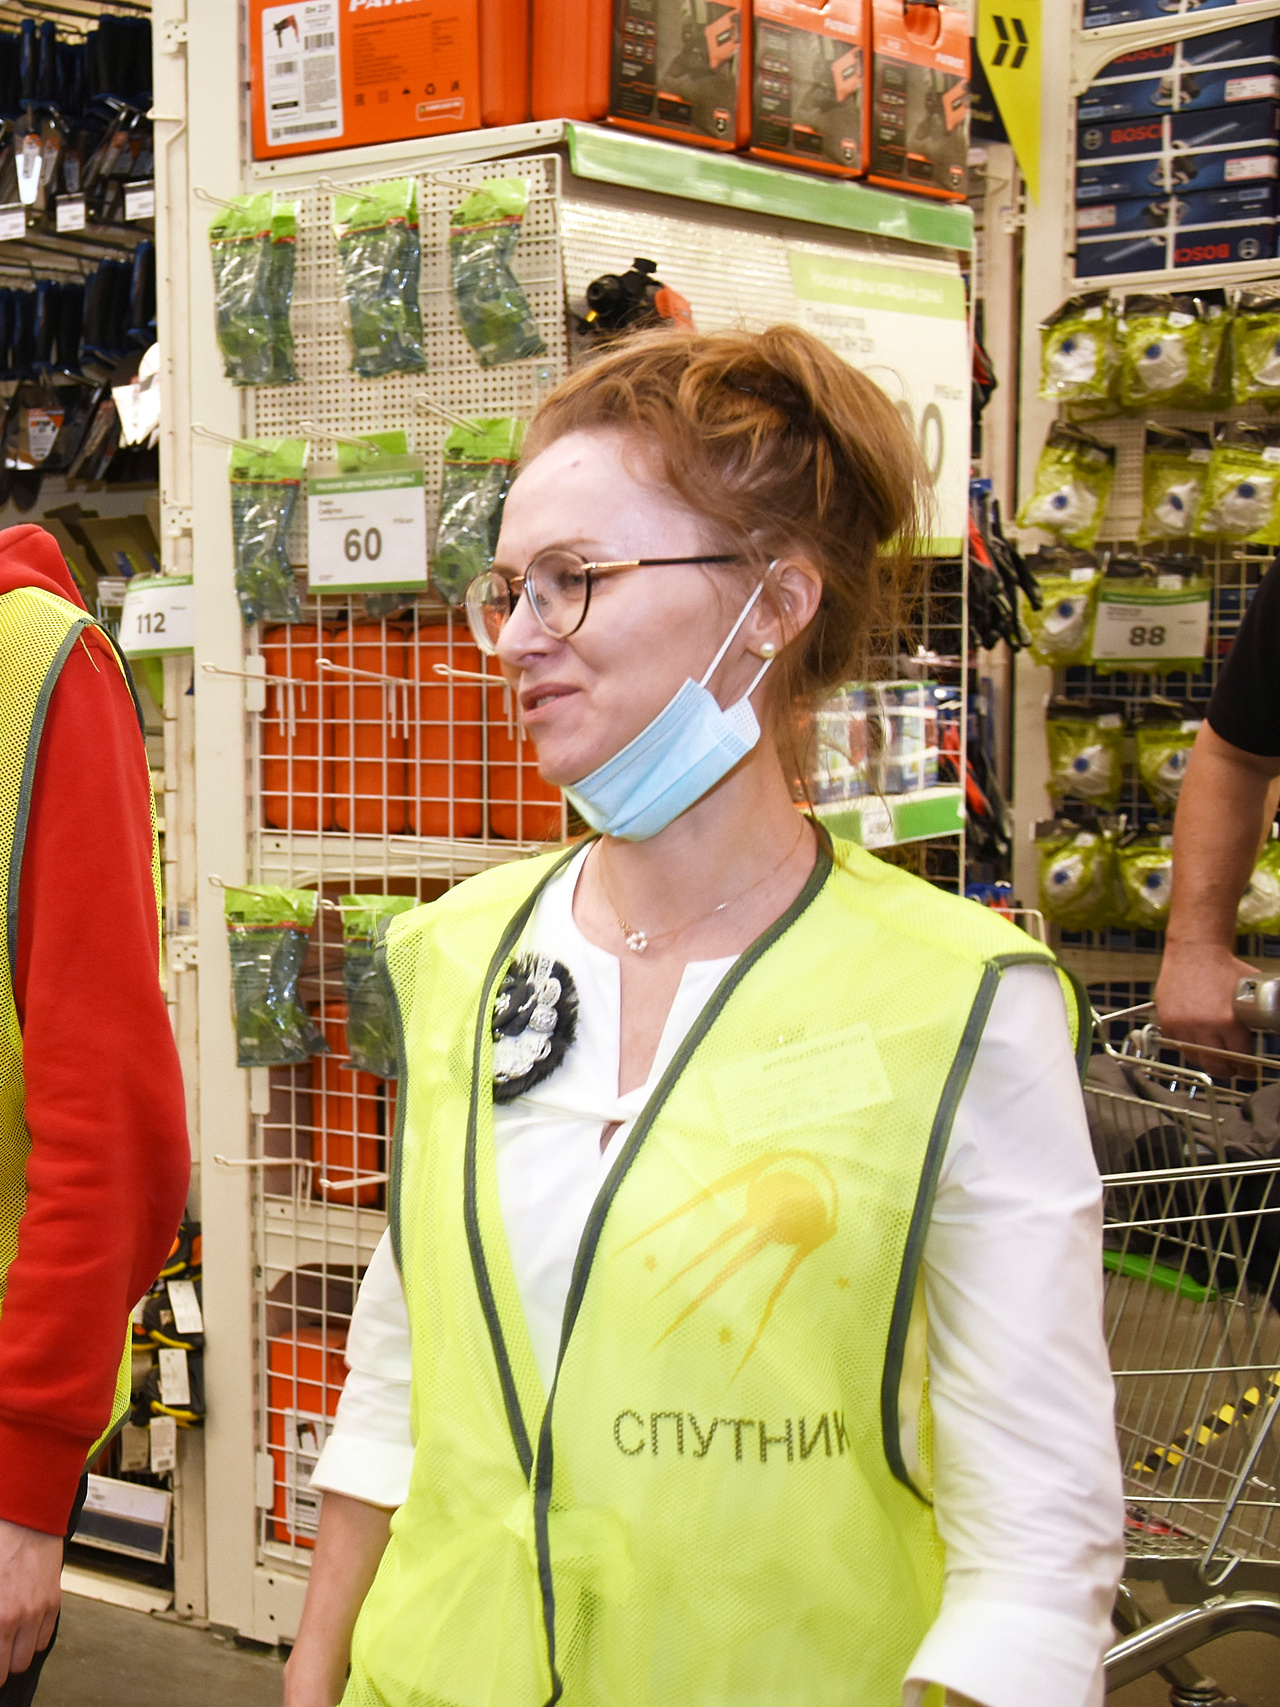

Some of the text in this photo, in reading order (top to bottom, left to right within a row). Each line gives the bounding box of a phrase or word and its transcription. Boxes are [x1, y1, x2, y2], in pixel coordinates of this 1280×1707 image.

[344, 527, 382, 562] 60
[137, 611, 166, 634] 112
[1129, 625, 1167, 647] 88
[614, 1407, 851, 1462] СПУТНИК
